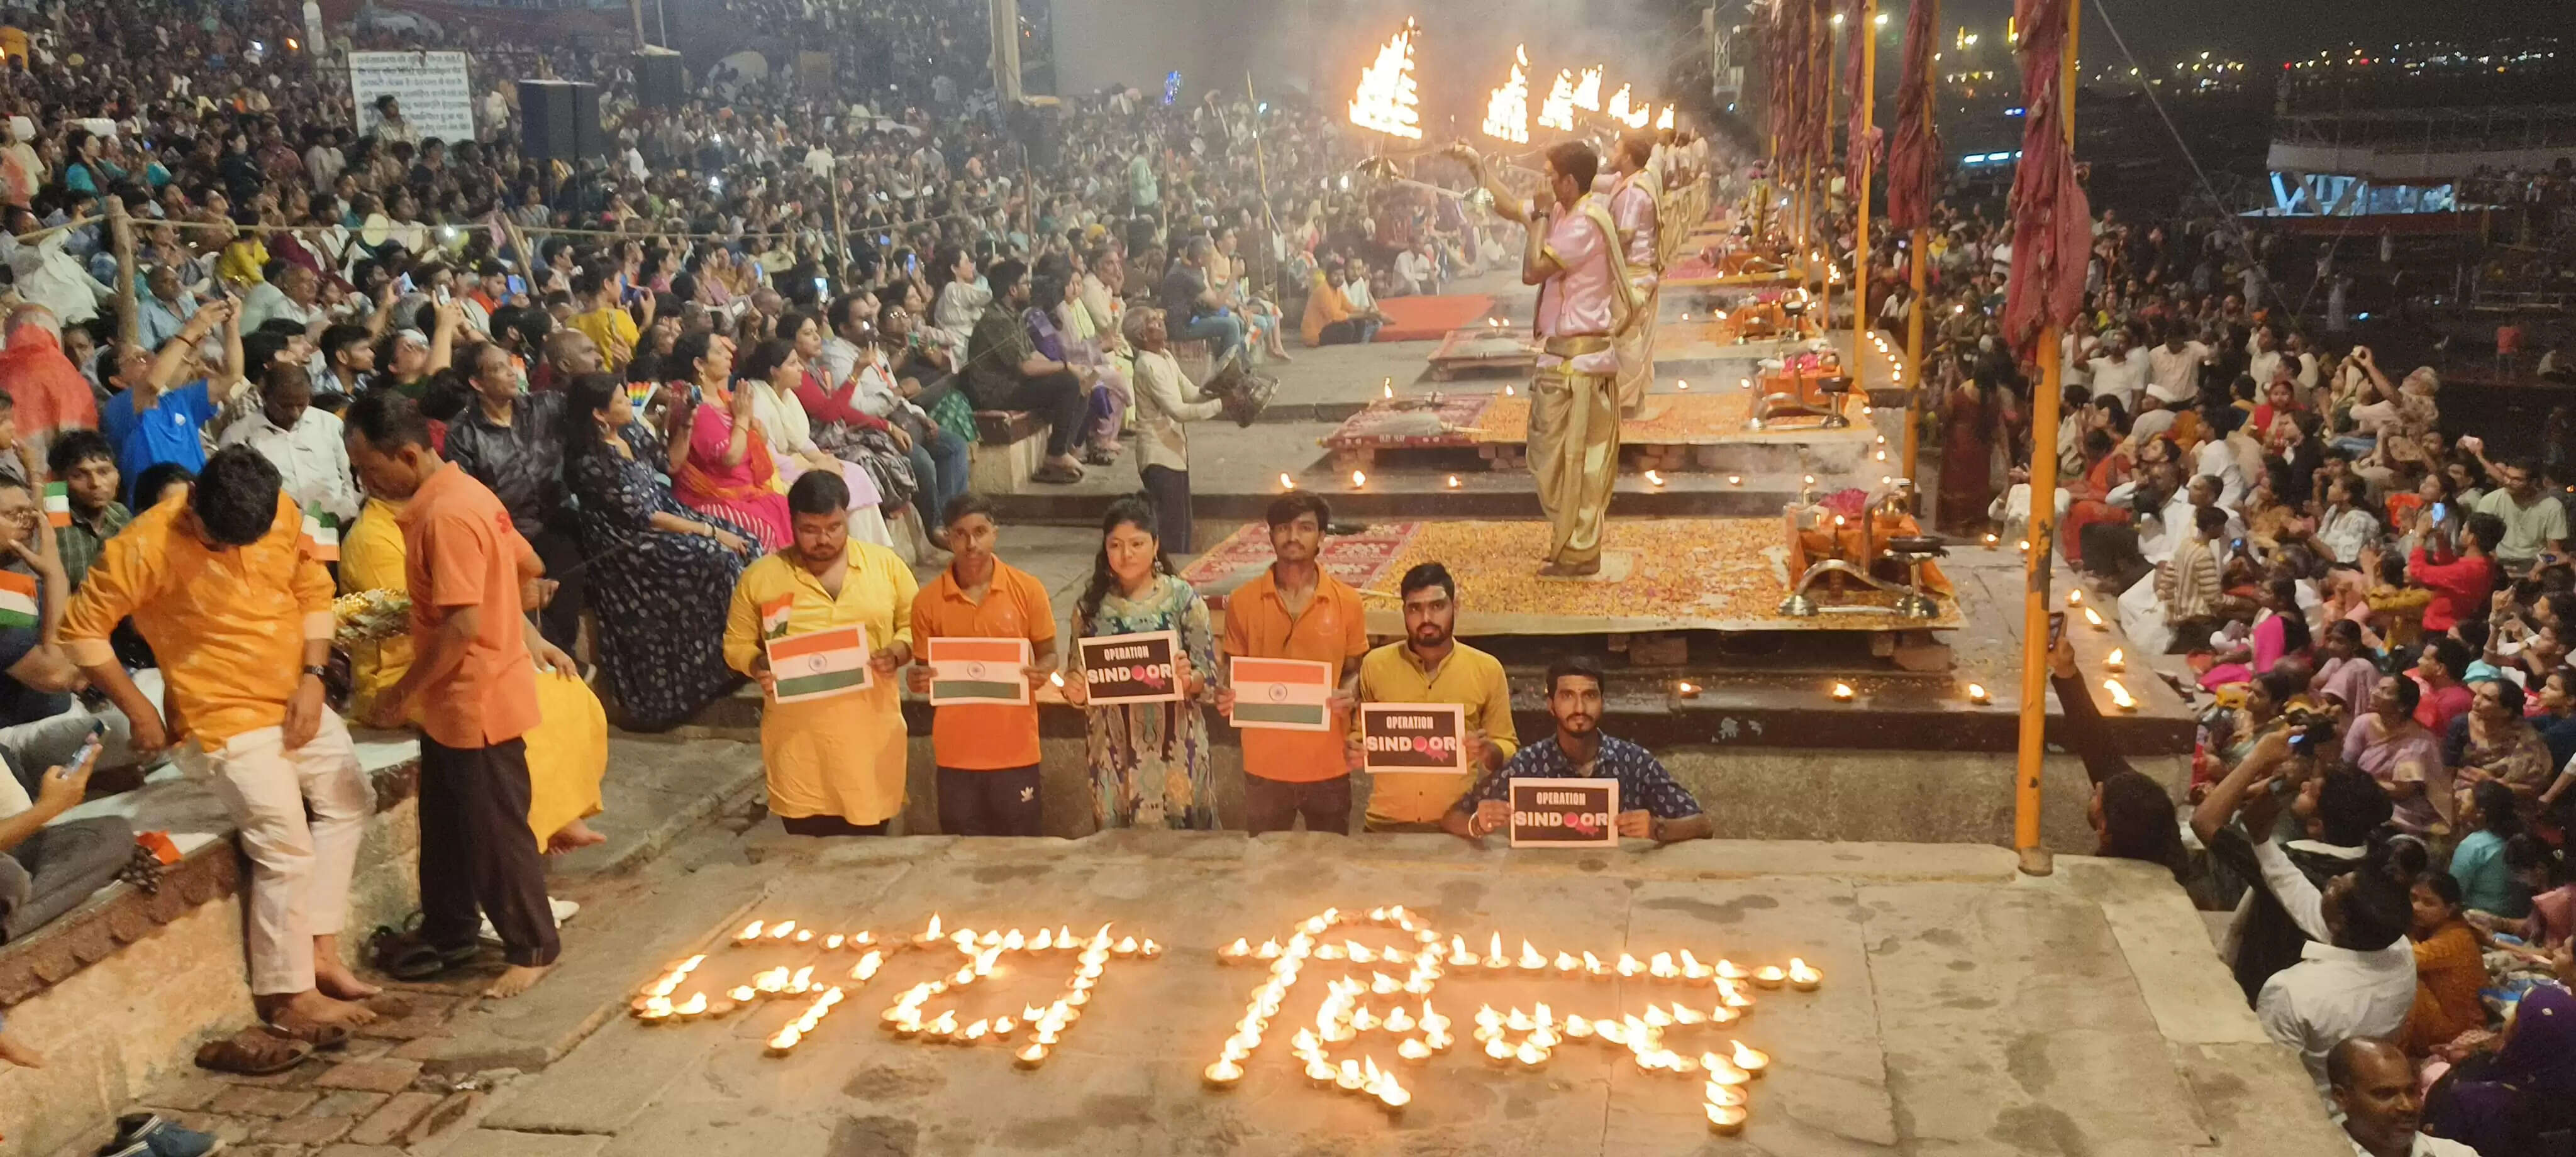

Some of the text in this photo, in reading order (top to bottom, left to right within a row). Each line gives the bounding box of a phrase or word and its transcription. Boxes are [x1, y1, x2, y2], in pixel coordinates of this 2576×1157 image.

[1104, 645, 1149, 661] OPERATION
[1087, 663, 1172, 684] SINDOOR
[1386, 716, 1434, 729] OPERATION
[1367, 736, 1457, 752] SINDOOR
[1536, 792, 1586, 805] OPERATION
[1514, 811, 1608, 828] SINDOOR
[631, 912, 1162, 1068] जय
